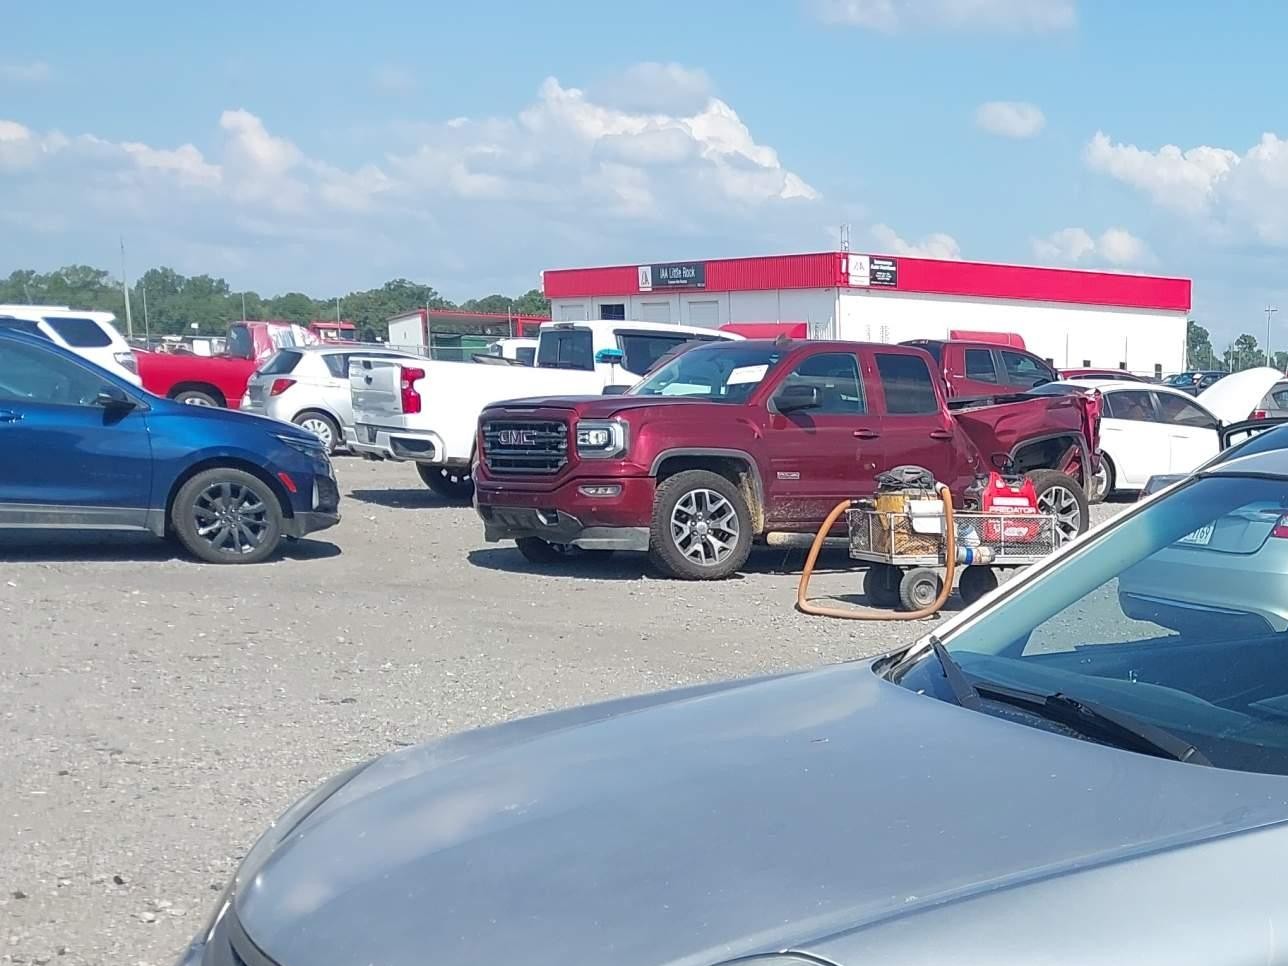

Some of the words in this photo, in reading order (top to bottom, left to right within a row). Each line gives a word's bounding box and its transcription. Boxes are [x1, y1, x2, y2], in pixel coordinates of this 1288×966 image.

[660, 267, 668, 279] IAA
[669, 267, 681, 279] Little
[682, 266, 695, 278] Rock
[498, 430, 536, 445] GMC
[989, 505, 1036, 514] PREDATOR
